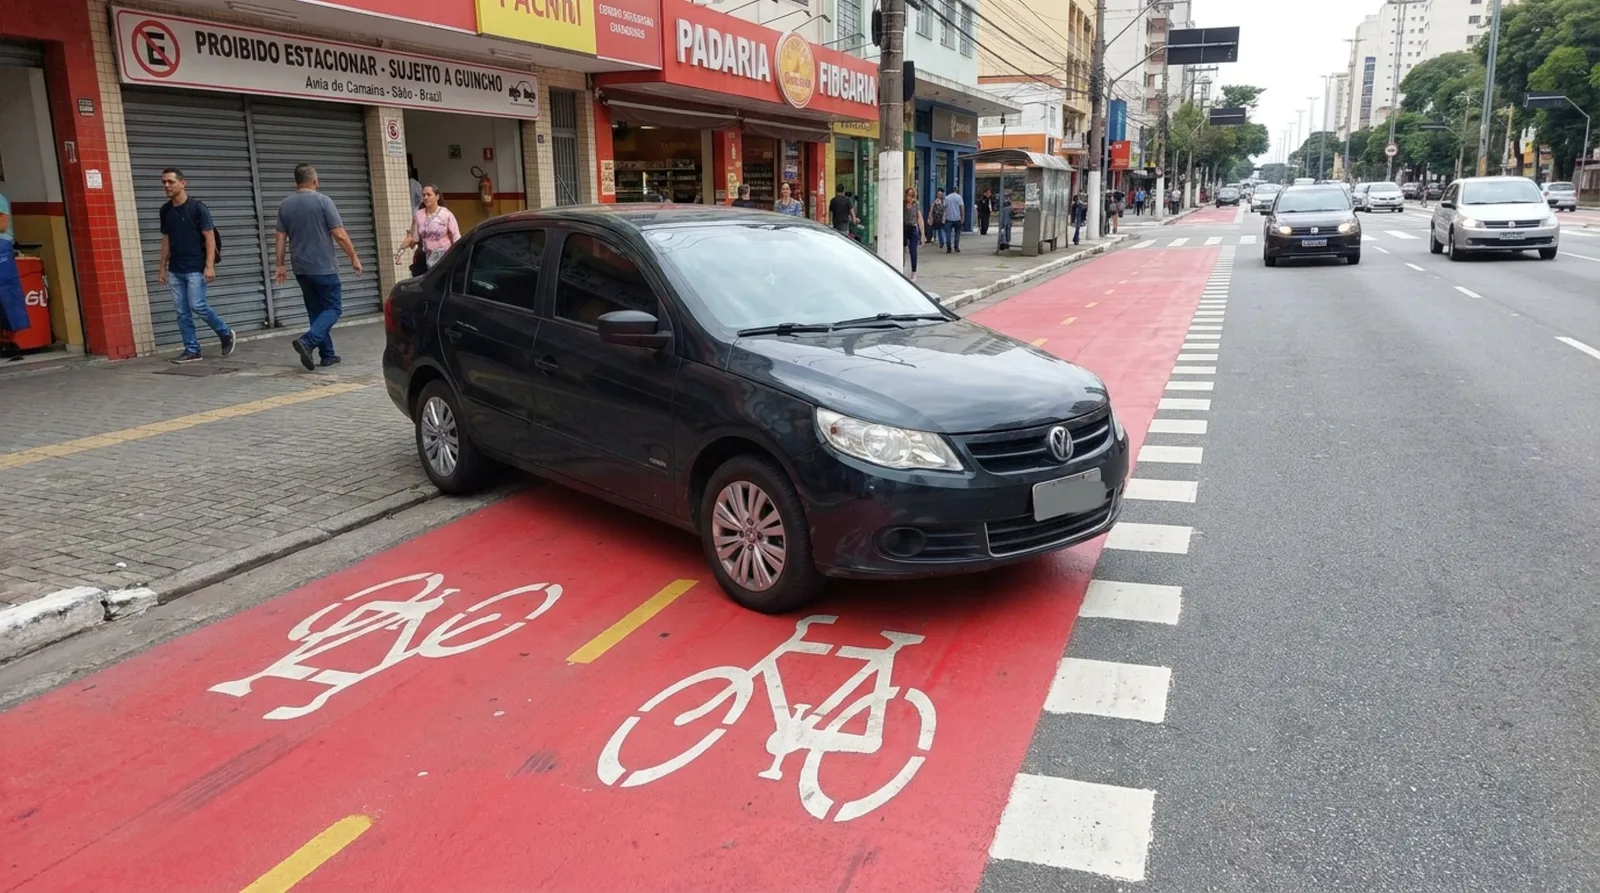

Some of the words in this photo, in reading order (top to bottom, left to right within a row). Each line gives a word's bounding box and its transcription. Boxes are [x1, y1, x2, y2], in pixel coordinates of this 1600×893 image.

[195, 31, 280, 64] PROIBIDO
[284, 44, 378, 76] ESTACIONAR
[389, 59, 441, 84] SUJEITO
[444, 66, 452, 86] A
[455, 68, 503, 93] GUINCHO
[676, 17, 771, 83] PADARIA
[332, 79, 344, 92] de
